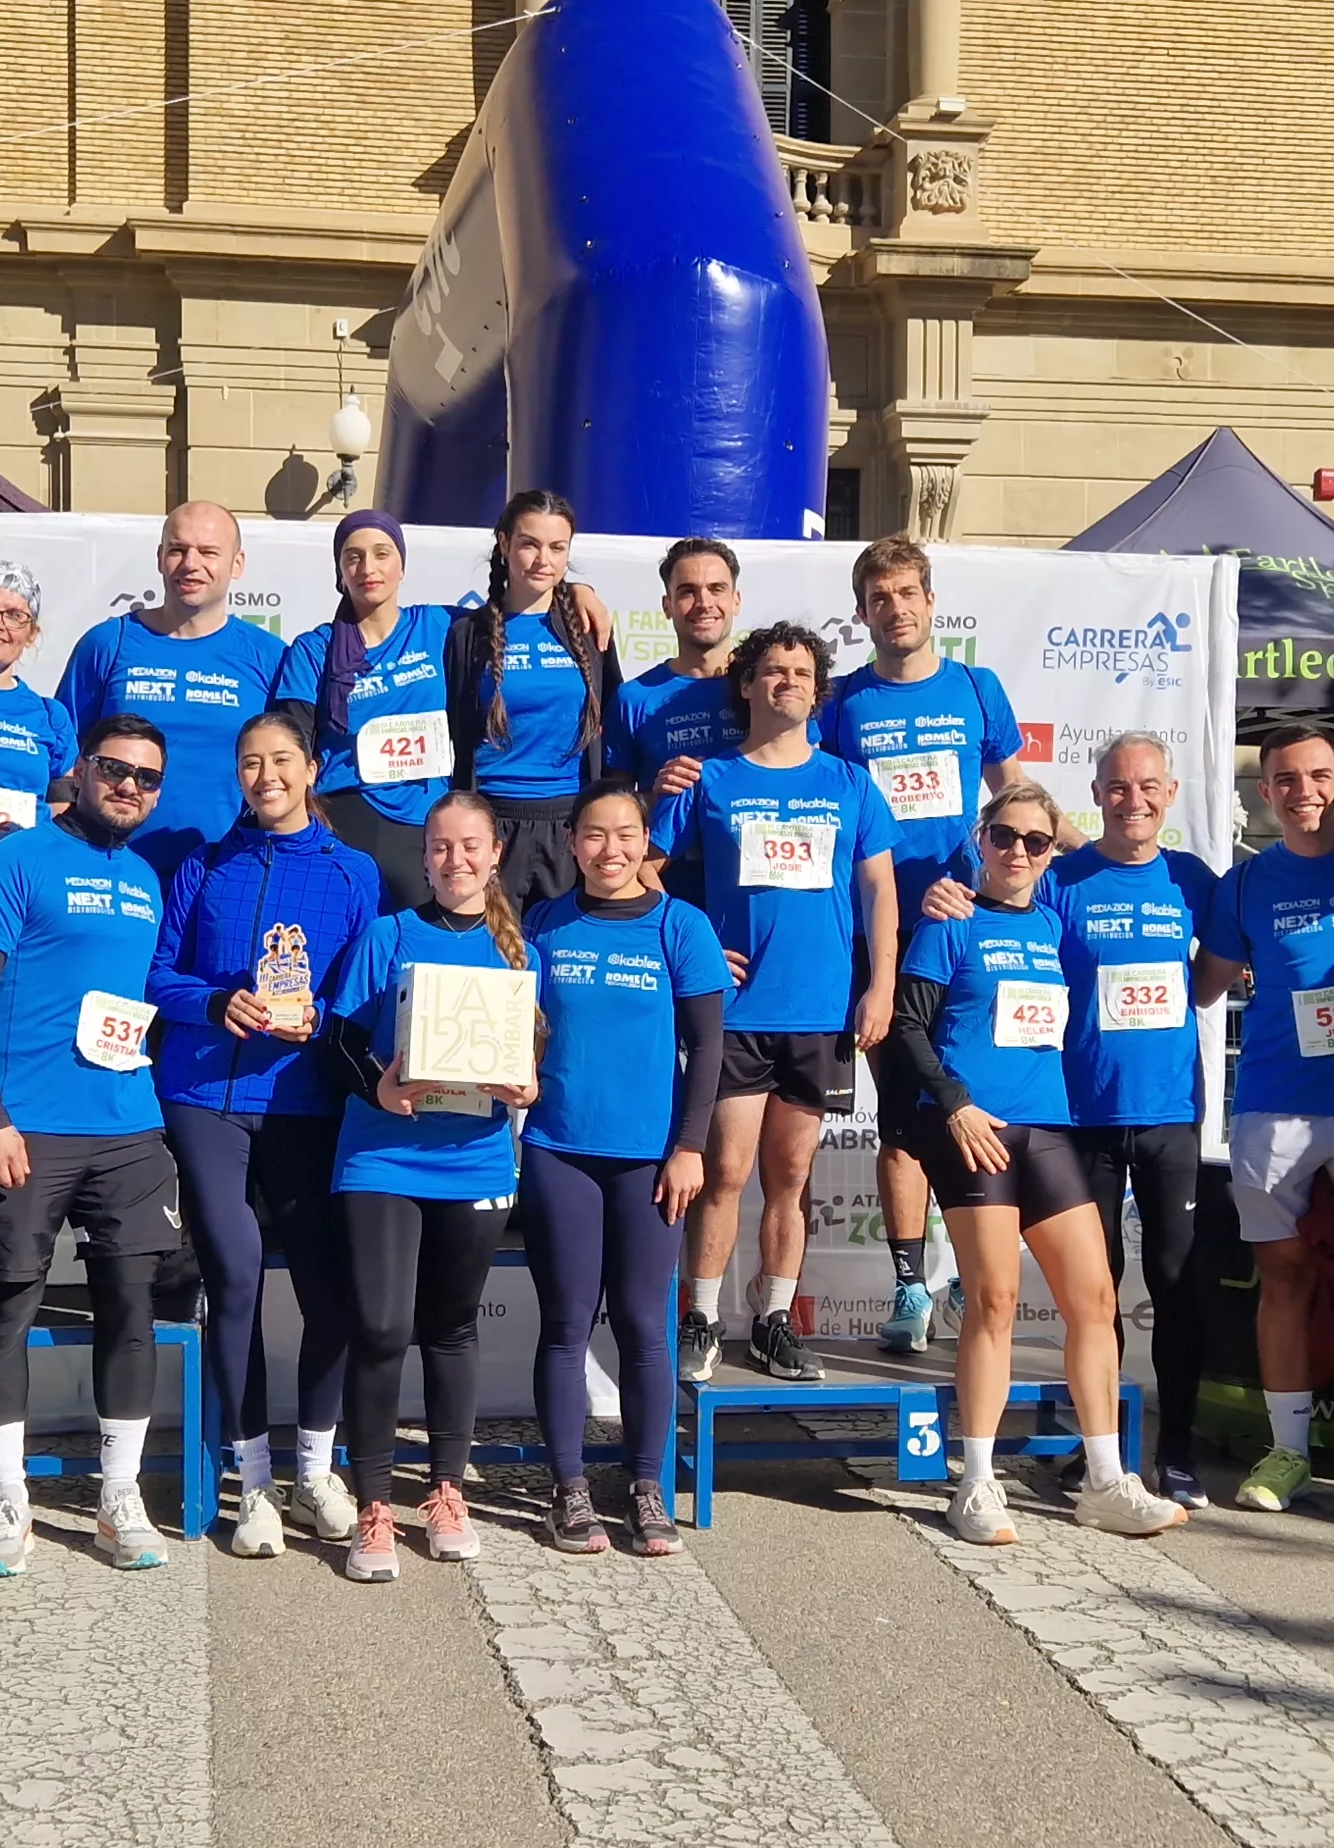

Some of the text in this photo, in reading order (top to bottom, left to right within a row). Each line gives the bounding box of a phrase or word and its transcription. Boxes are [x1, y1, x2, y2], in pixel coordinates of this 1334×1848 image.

[1047, 626, 1168, 649] CARRERA
[1043, 649, 1169, 672] EMPRESAS
[199, 671, 239, 688] kablex
[352, 676, 383, 694] EXT
[1142, 677, 1155, 688] By
[126, 681, 176, 696] NEXT
[666, 726, 712, 743] NEXT
[861, 731, 907, 749] NEXT
[380, 735, 426, 757] 421
[388, 758, 424, 768] RIHAB
[1058, 747, 1081, 764] de
[892, 770, 940, 793] 333
[731, 798, 780, 809] MEDIAZION
[731, 811, 780, 825] NEXT
[764, 840, 812, 861] 393
[67, 892, 113, 908] NEXT
[1086, 903, 1134, 913] MEDIAZION
[1272, 898, 1321, 911] MEDIAZION
[1087, 918, 1134, 933] NEXT
[1274, 913, 1322, 931] NEXT
[552, 949, 600, 961] MEDIAZION
[620, 953, 662, 971] kablex
[983, 951, 1025, 966] NEXT
[550, 964, 597, 979] NEXT
[1121, 985, 1168, 1006] 332
[1012, 1004, 1056, 1024] 423
[1120, 1006, 1171, 1017] ENRIQUE
[101, 1015, 144, 1046] 531
[503, 999, 523, 1077] AMBAR
[1018, 1026, 1055, 1036] HELEN
[420, 1015, 499, 1075] 125
[425, 1095, 443, 1105] 8K
[819, 1318, 883, 1336] de Hue
[907, 1412, 941, 1457] 3
